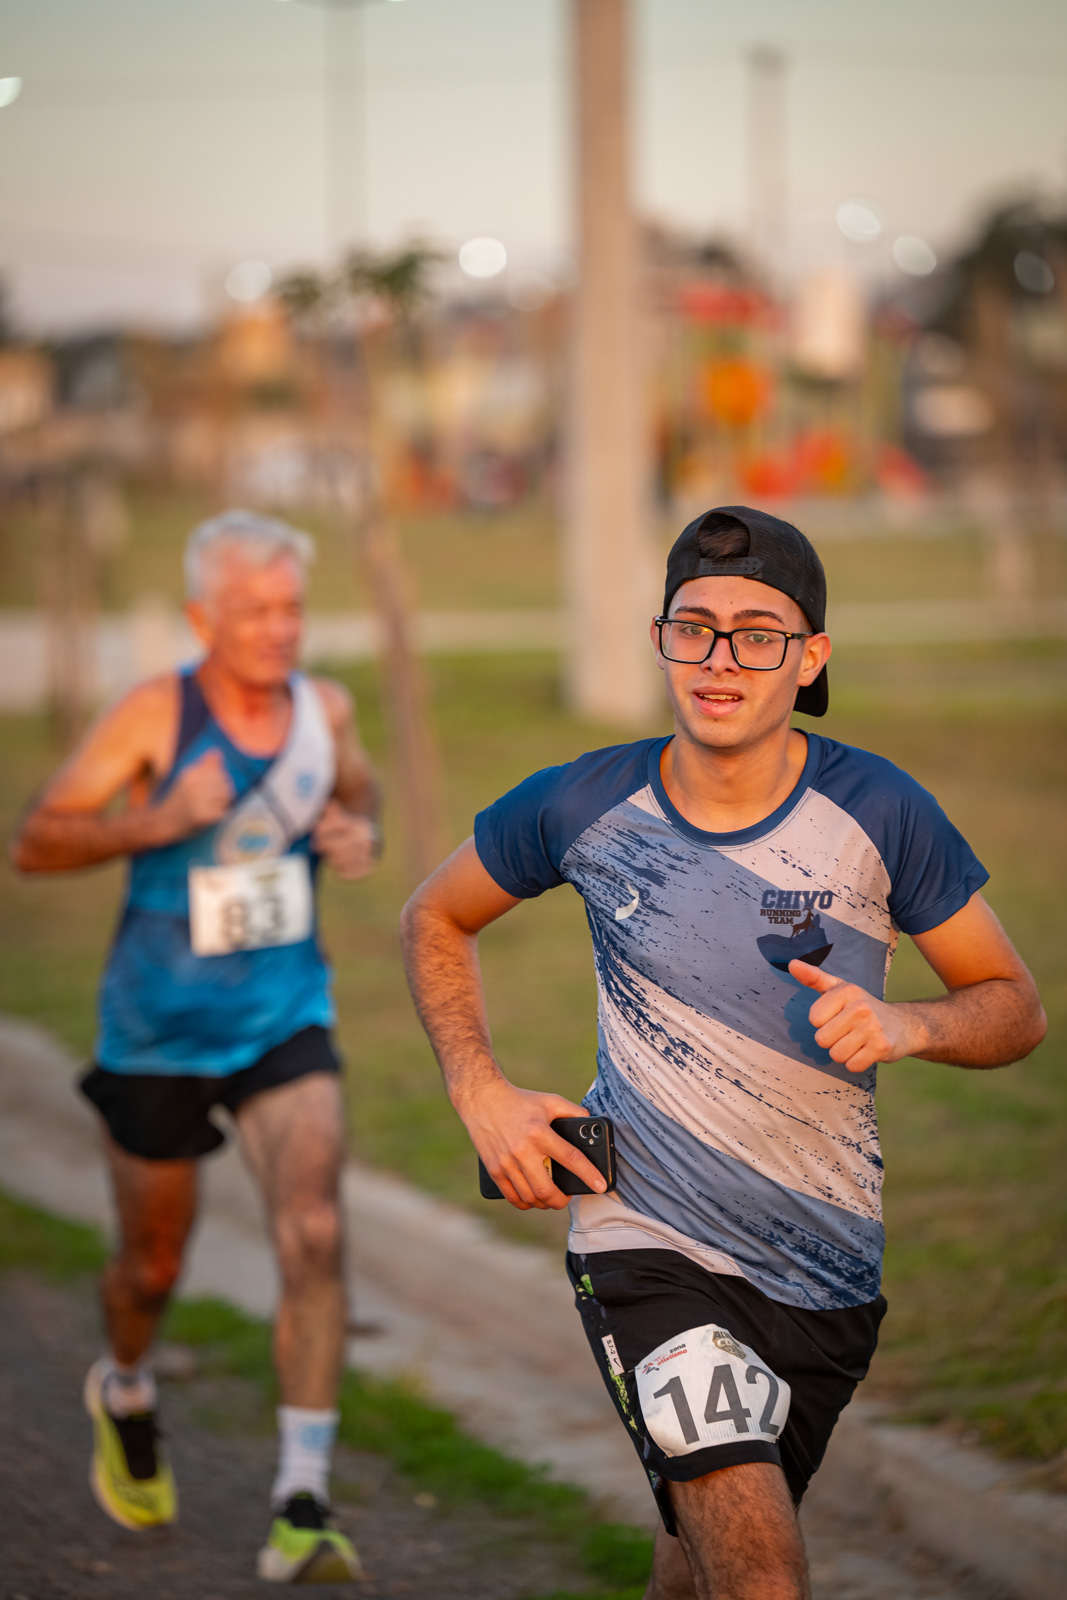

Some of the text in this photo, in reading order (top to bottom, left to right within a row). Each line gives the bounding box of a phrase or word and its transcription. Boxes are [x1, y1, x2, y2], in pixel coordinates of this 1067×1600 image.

[761, 889, 834, 910] CHIVO
[760, 909, 801, 917] RUNNING
[768, 917, 794, 925] TEAM
[669, 1343, 686, 1354] zona
[657, 1349, 688, 1366] atletismo
[653, 1364, 780, 1445] 142
